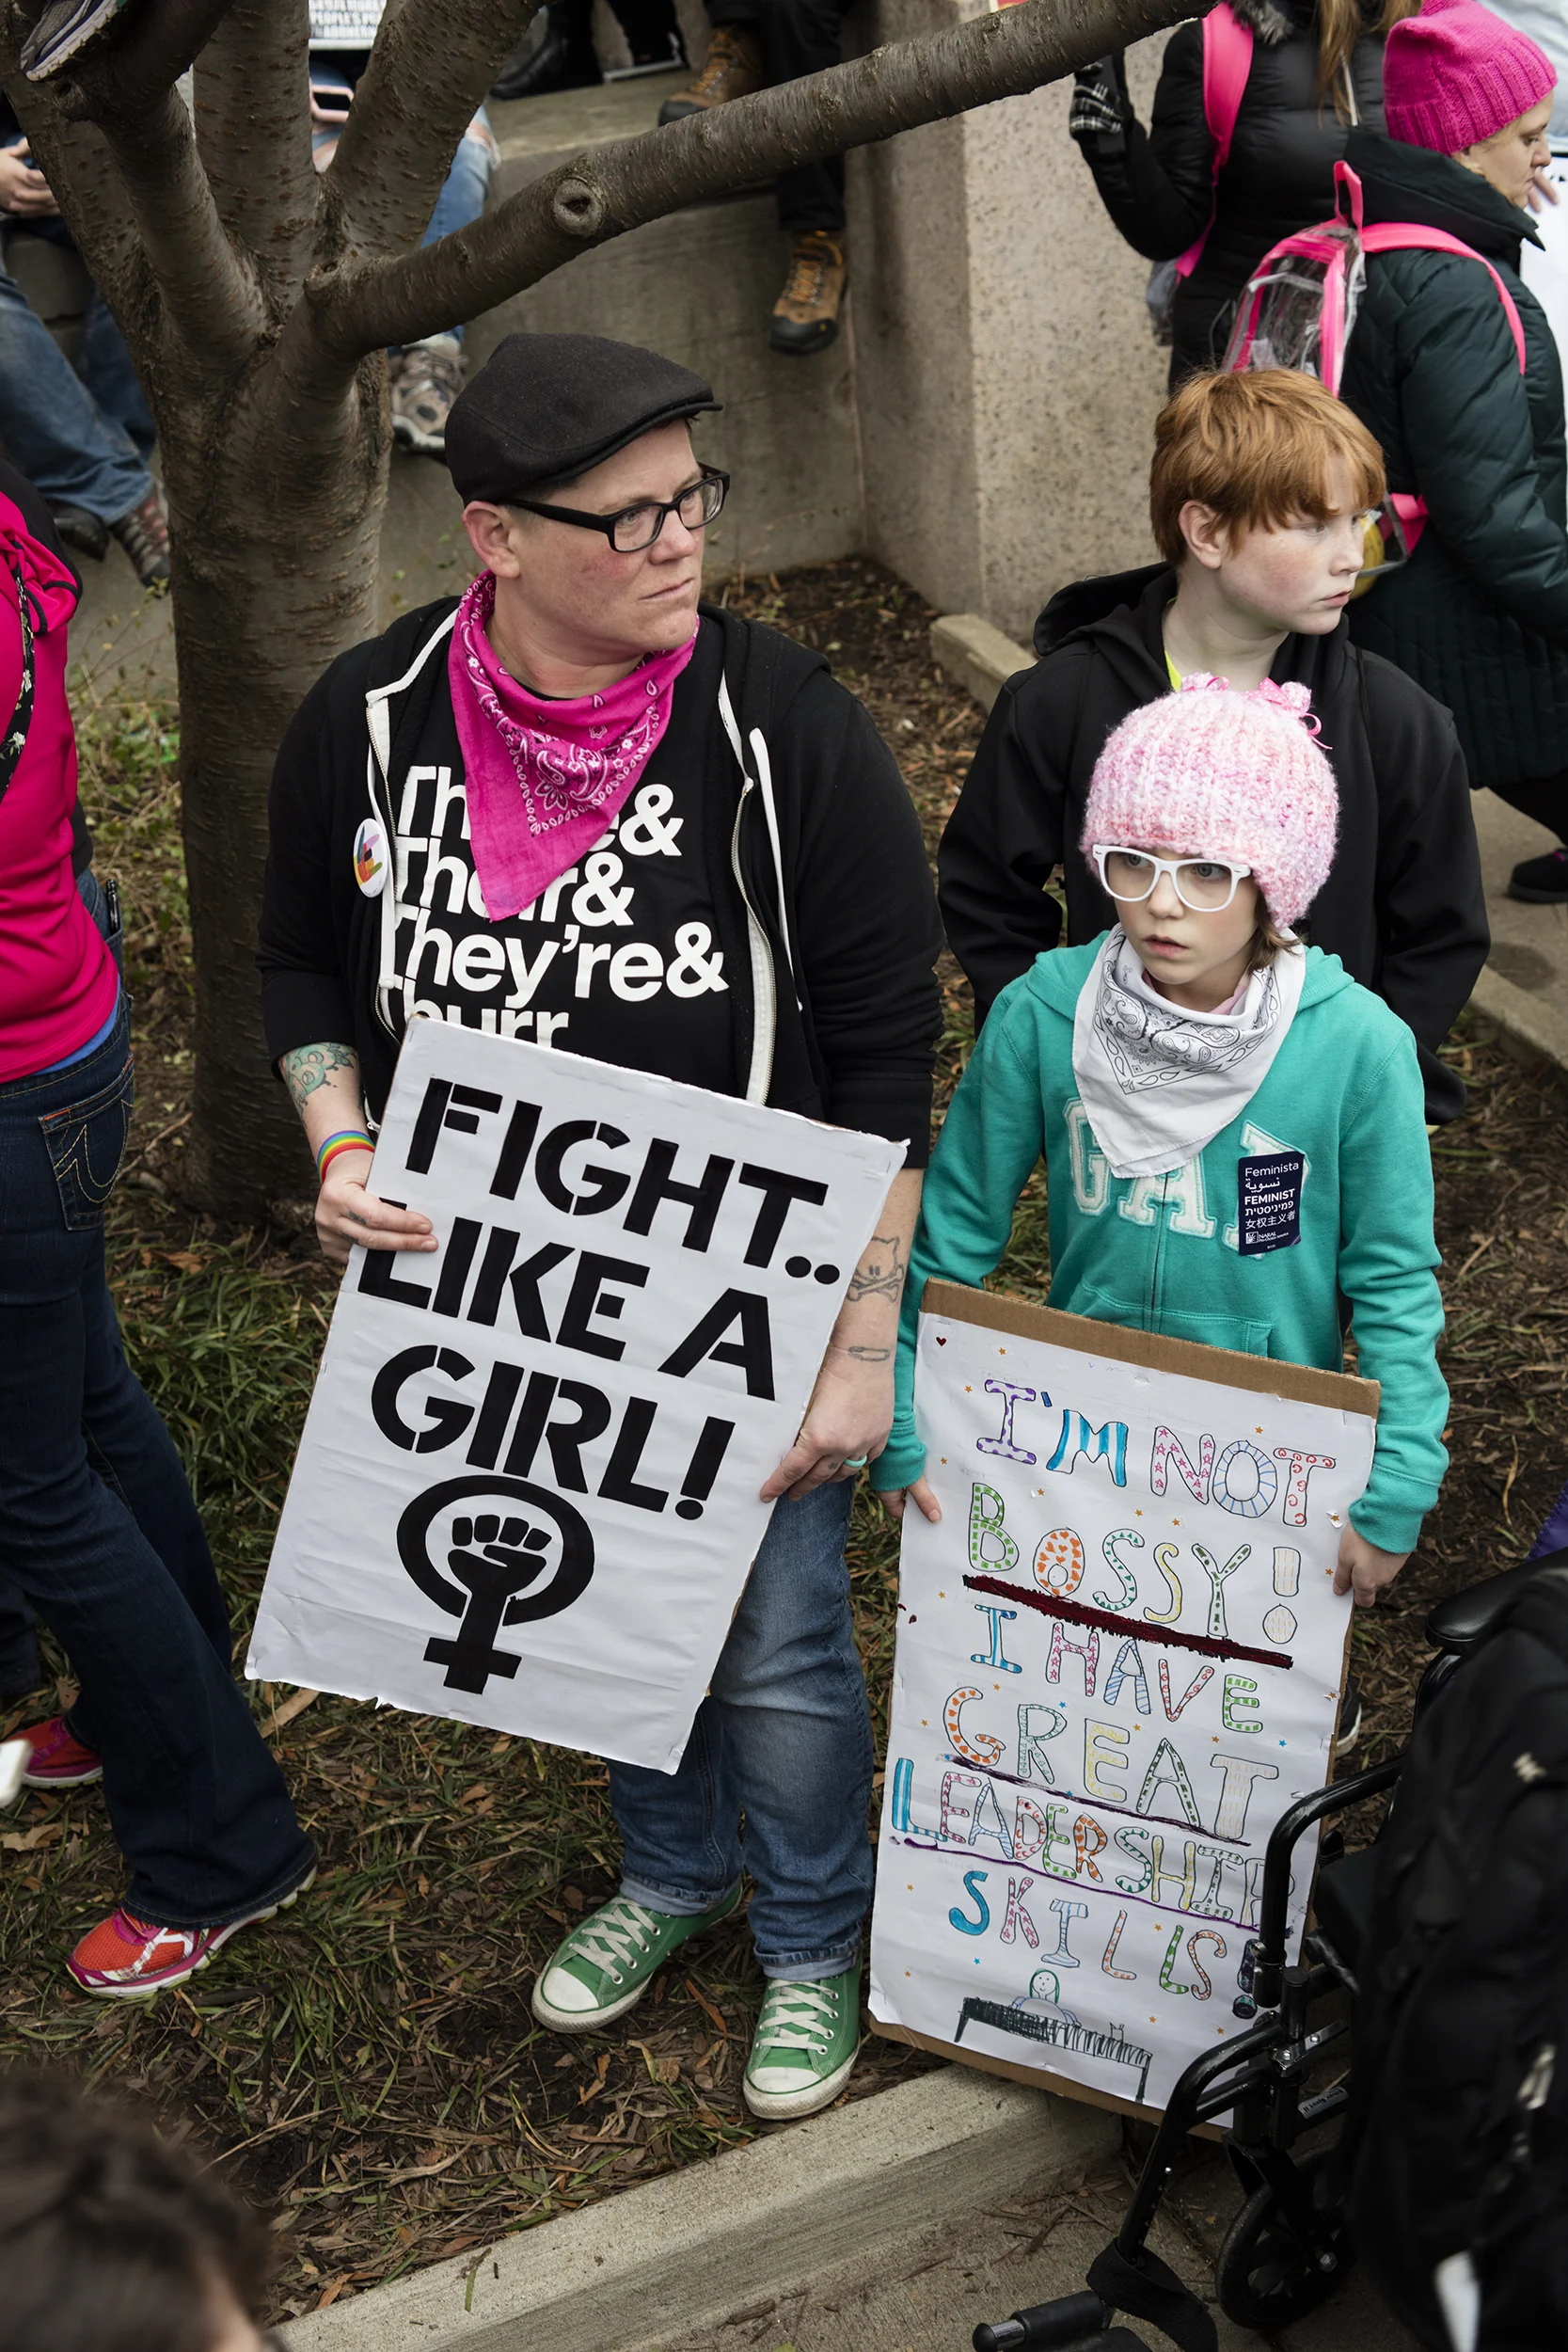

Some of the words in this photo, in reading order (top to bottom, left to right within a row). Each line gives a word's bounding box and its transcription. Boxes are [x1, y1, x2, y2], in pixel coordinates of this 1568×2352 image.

[1244, 1162, 1299, 1178] Feminista
[1244, 1177, 1281, 1193] نسوية
[1244, 1187, 1296, 1205] FEMINIST
[1244, 1200, 1295, 1216] פמיניסטית
[1244, 1210, 1296, 1231] 女权主义者
[357, 1198, 651, 1361] LIKE
[657, 1287, 776, 1402] A
[371, 1345, 736, 1520] GIRL!
[976, 1378, 1130, 1488] I'M
[1149, 1425, 1337, 1528] NOT
[967, 1482, 1302, 1645] BOSSY!
[970, 1603, 1023, 1674] I
[1045, 1622, 1263, 1733] HAVE
[942, 1686, 1280, 1840] GREAT
[1308, 2097, 1327, 2109] Sport
